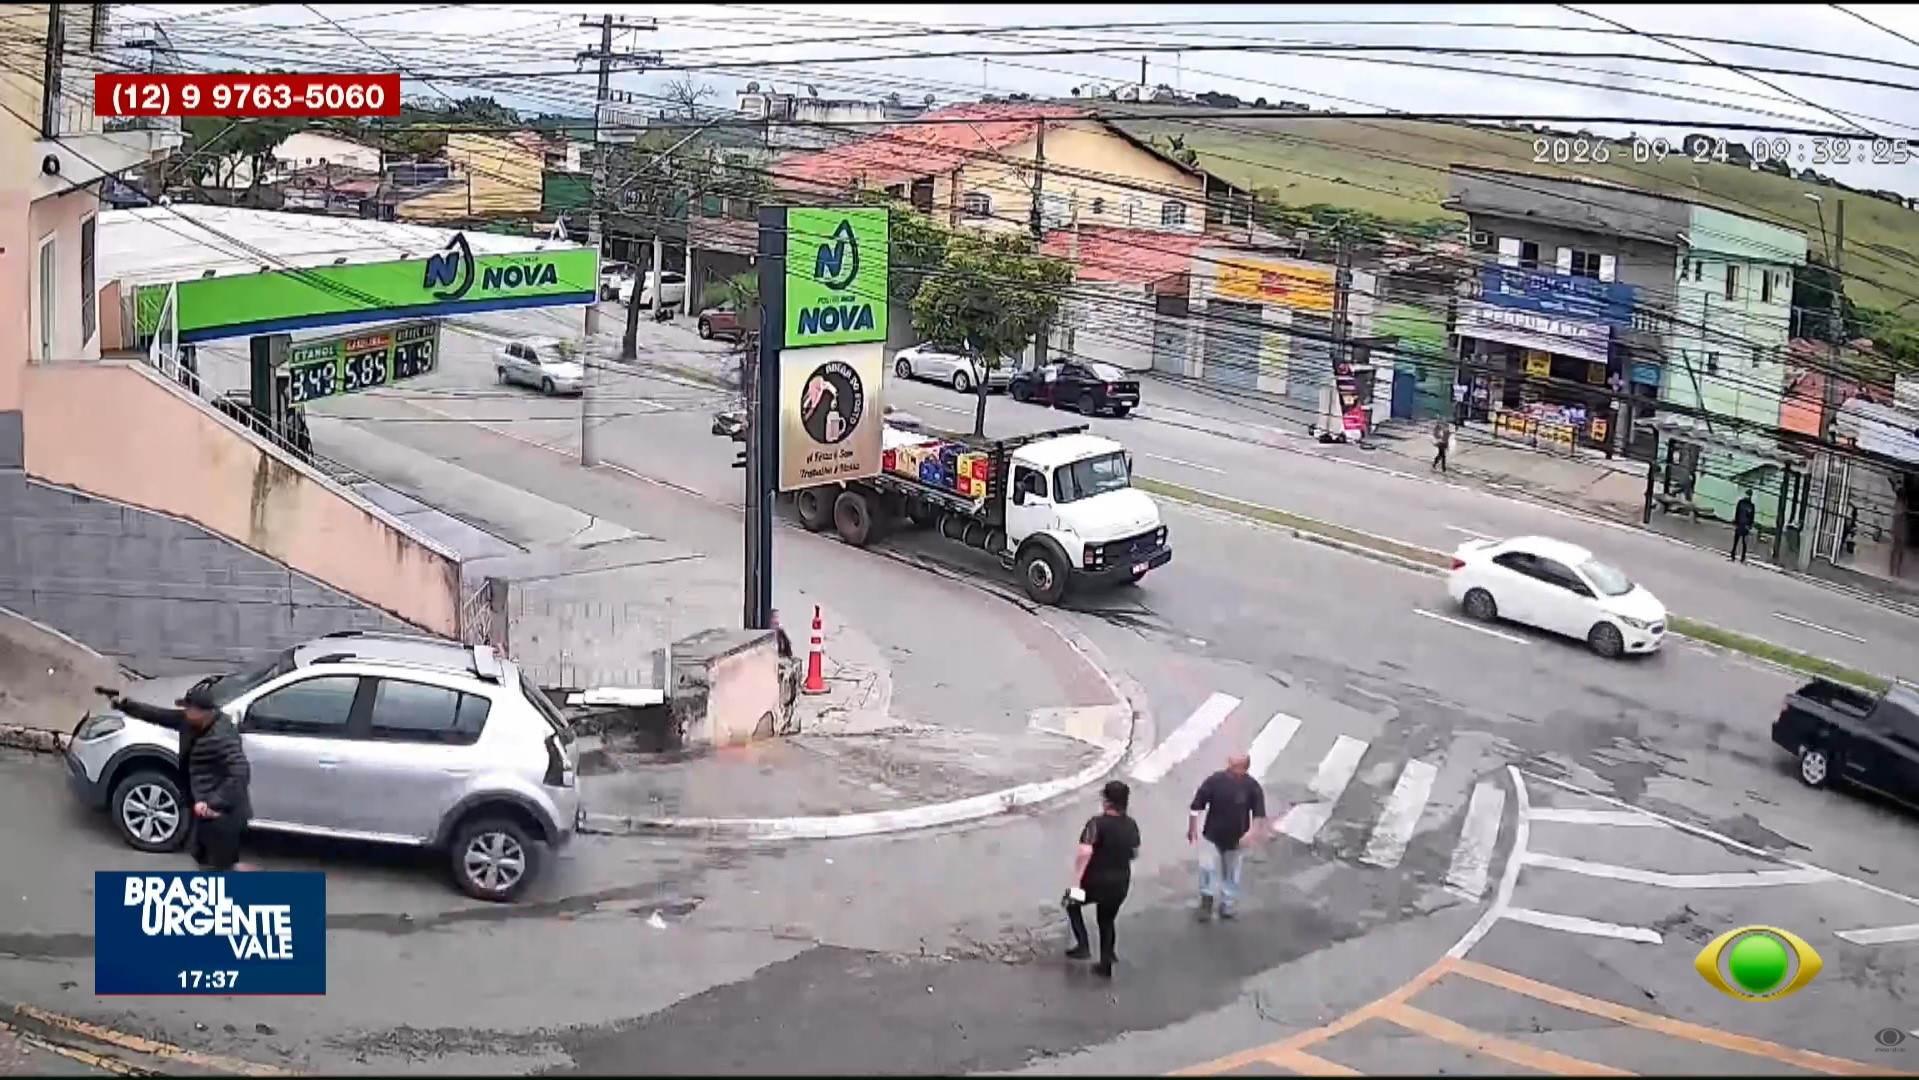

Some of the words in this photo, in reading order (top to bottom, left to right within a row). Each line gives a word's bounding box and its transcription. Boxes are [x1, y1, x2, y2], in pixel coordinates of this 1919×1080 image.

[481, 263, 558, 290] NOVA
[797, 303, 875, 335] NOVA
[294, 345, 334, 362] ETANOL
